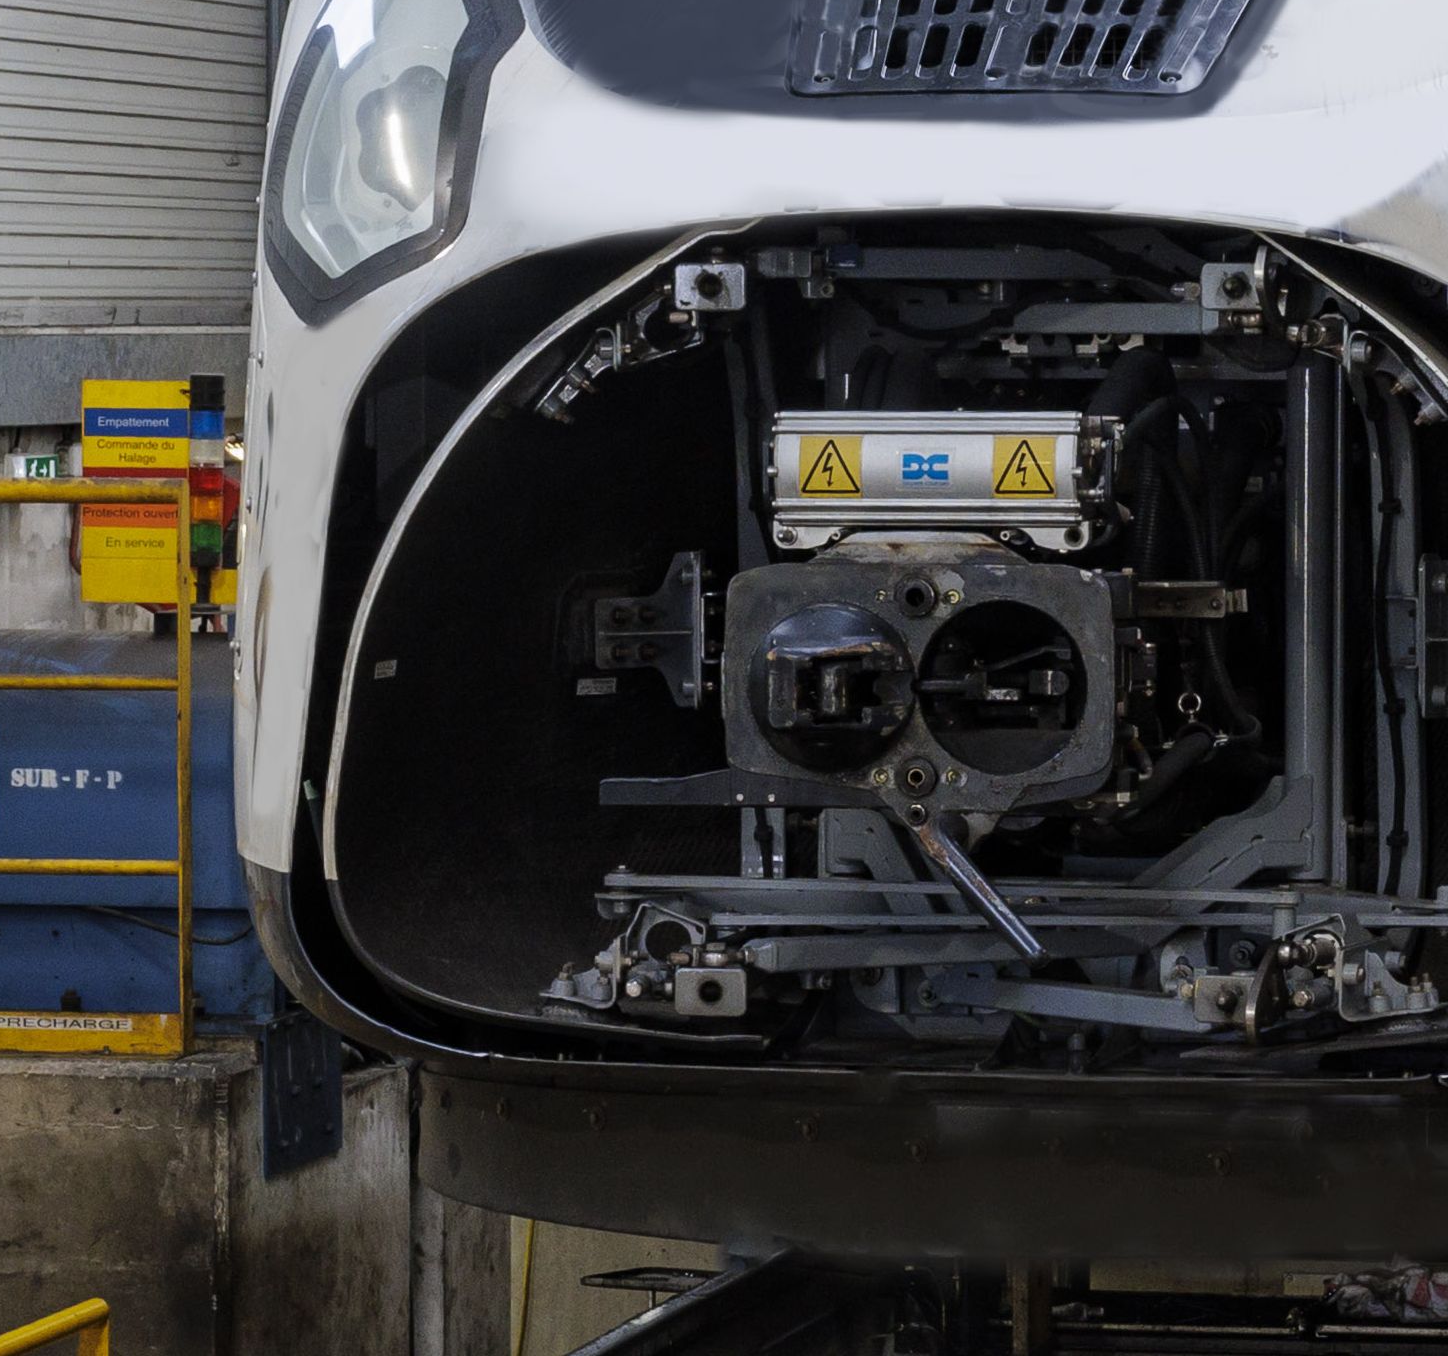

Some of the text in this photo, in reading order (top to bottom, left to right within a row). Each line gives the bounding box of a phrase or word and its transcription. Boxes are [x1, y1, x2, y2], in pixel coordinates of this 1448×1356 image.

[97, 416, 170, 430] Empattement
[96, 439, 175, 451] Commande du
[118, 453, 157, 466] Halage
[82, 506, 140, 518] Protection
[105, 537, 165, 548] En service
[11, 768, 59, 788] SUR
